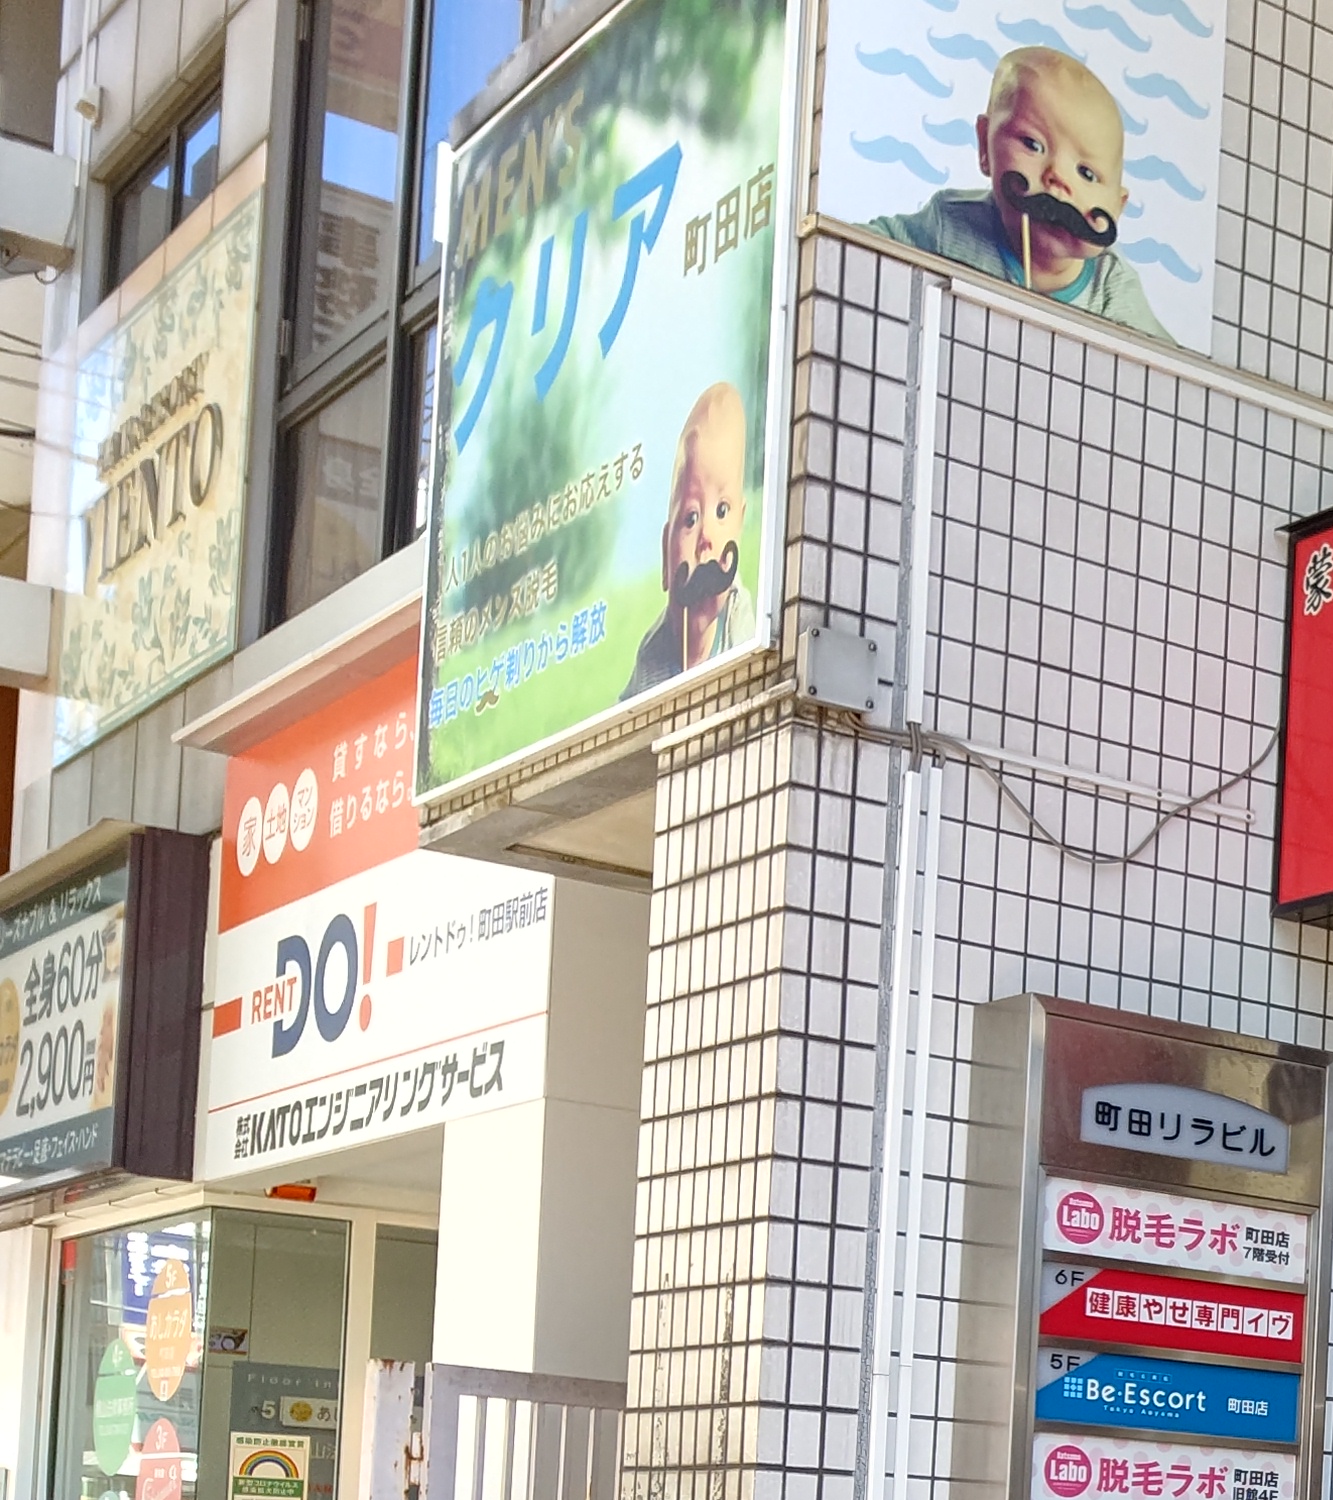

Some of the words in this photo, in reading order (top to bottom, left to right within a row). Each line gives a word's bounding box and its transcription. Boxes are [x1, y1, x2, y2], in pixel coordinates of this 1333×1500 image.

[682, 163, 776, 277] 町田店
[453, 142, 683, 454] クリア
[430, 602, 608, 728] 毎日のヒゲ剃りから解放
[242, 817, 257, 859] 家
[265, 810, 287, 840] 土地
[23, 930, 103, 1027] 全身60分
[251, 976, 297, 1025] RENT
[1095, 1101, 1276, 1157] 町田リラビル
[1062, 1204, 1100, 1231] Labo
[1109, 1207, 1241, 1256] 脱毛ラボ
[1245, 1226, 1291, 1249] 町田店
[1243, 1246, 1290, 1266] 7階受付
[1055, 1269, 1084, 1287] 6F
[1088, 1291, 1292, 1336] 健康やせ専門イヴ
[1050, 1354, 1081, 1372] 5F
[1228, 1397, 1269, 1417] 町田店
[1049, 1460, 1088, 1483] Labo
[1097, 1458, 1229, 1500] 脱毛ラボ
[1233, 1468, 1279, 1488] 町田店
